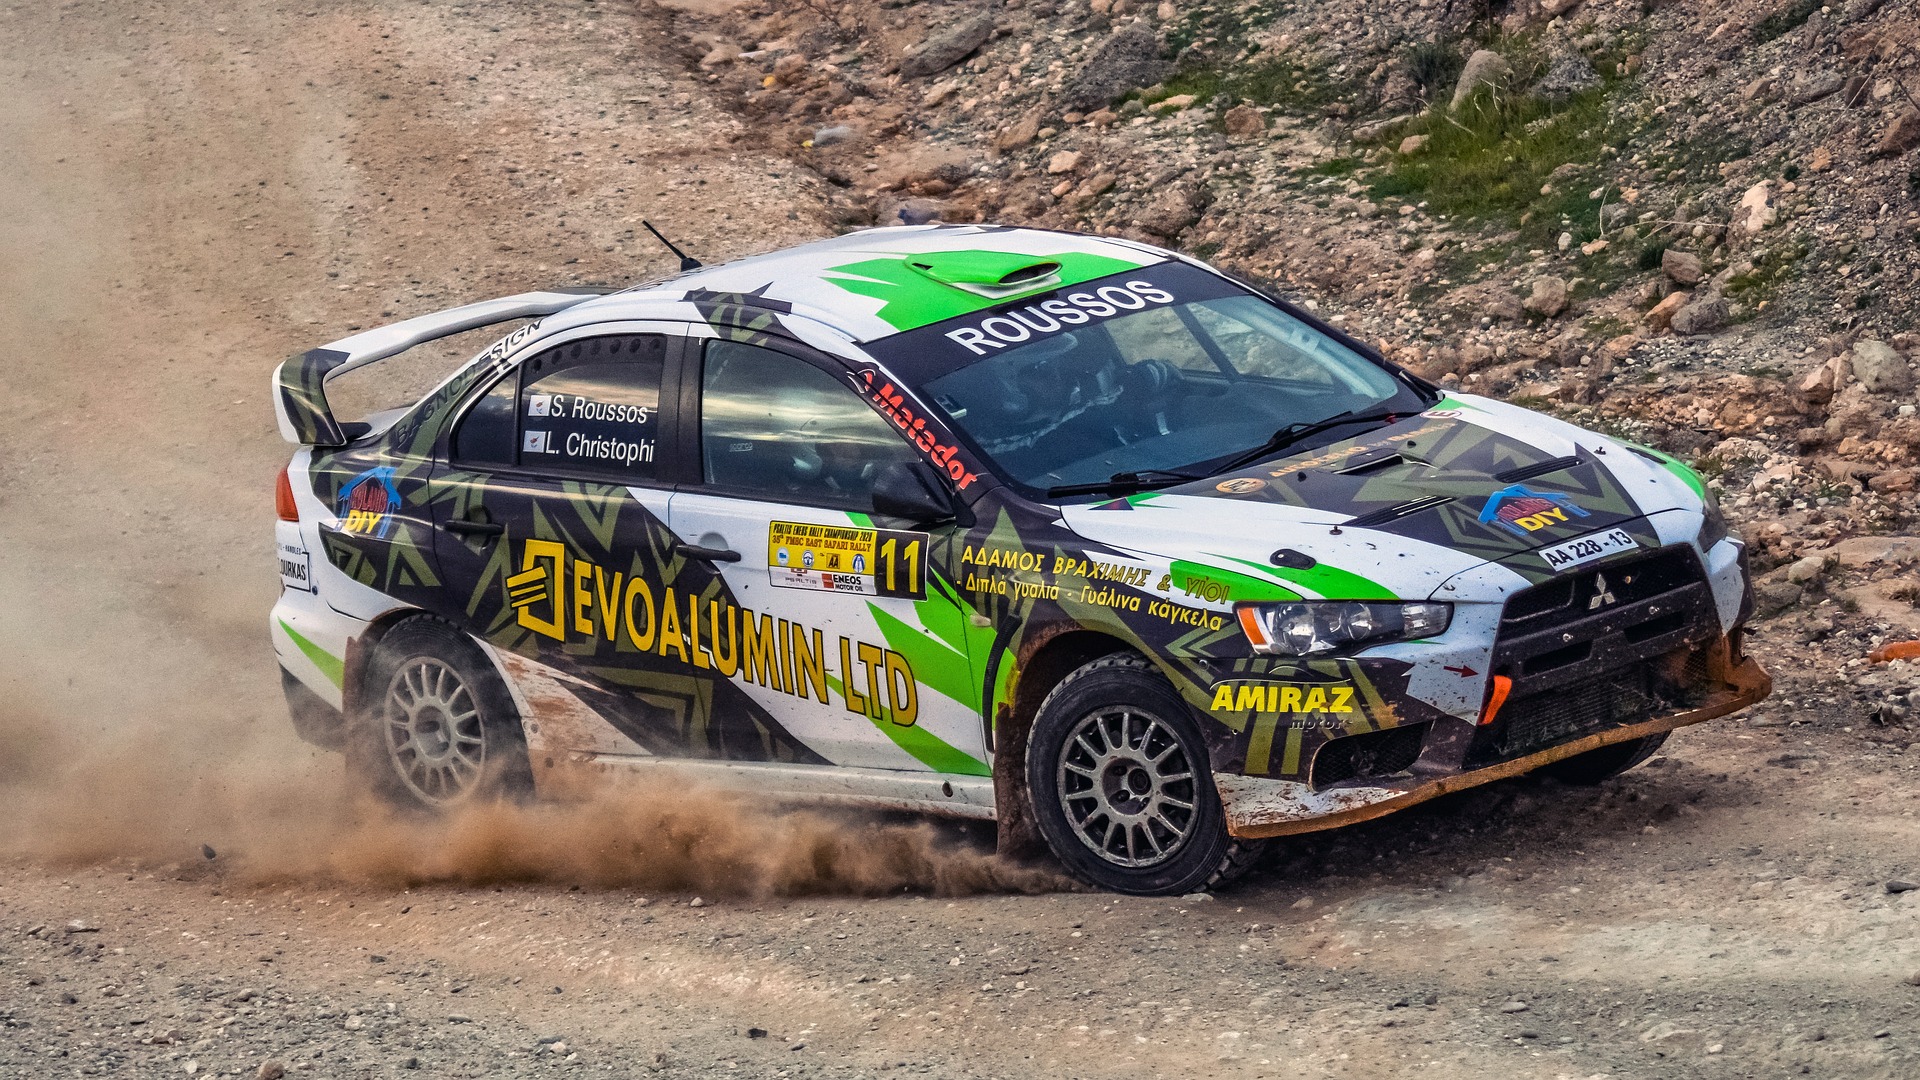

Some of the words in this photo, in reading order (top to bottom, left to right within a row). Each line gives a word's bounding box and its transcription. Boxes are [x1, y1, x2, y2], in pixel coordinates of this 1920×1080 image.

[945, 281, 1174, 355] ROUSSOS
[551, 395, 566, 418] S.
[572, 396, 648, 424] Roussos
[545, 431, 559, 454] L.
[566, 432, 655, 467] Christophi
[872, 383, 977, 489] Matador
[344, 509, 383, 534] DIY
[1513, 507, 1569, 531] DIY
[850, 542, 871, 552] RALLY
[1545, 551, 1575, 567] AA
[1568, 539, 1603, 559] 228
[1608, 531, 1632, 547] 13
[833, 574, 862, 585] ENEOS
[881, 538, 919, 593] 11
[961, 545, 1044, 573] ΑΔΑΜΟΣ
[1053, 556, 1151, 588] ΒΡΑΧΙΜΗΣ
[1156, 574, 1172, 592] &
[835, 584, 854, 592] MOTOR
[965, 572, 1007, 595] Διπλά
[1080, 584, 1141, 613] Γυάλινα
[1148, 598, 1222, 631] κάγκελα
[574, 558, 830, 706] EVOALUMIN
[839, 635, 919, 728] LTD
[1210, 684, 1354, 713] AMIRAZ
